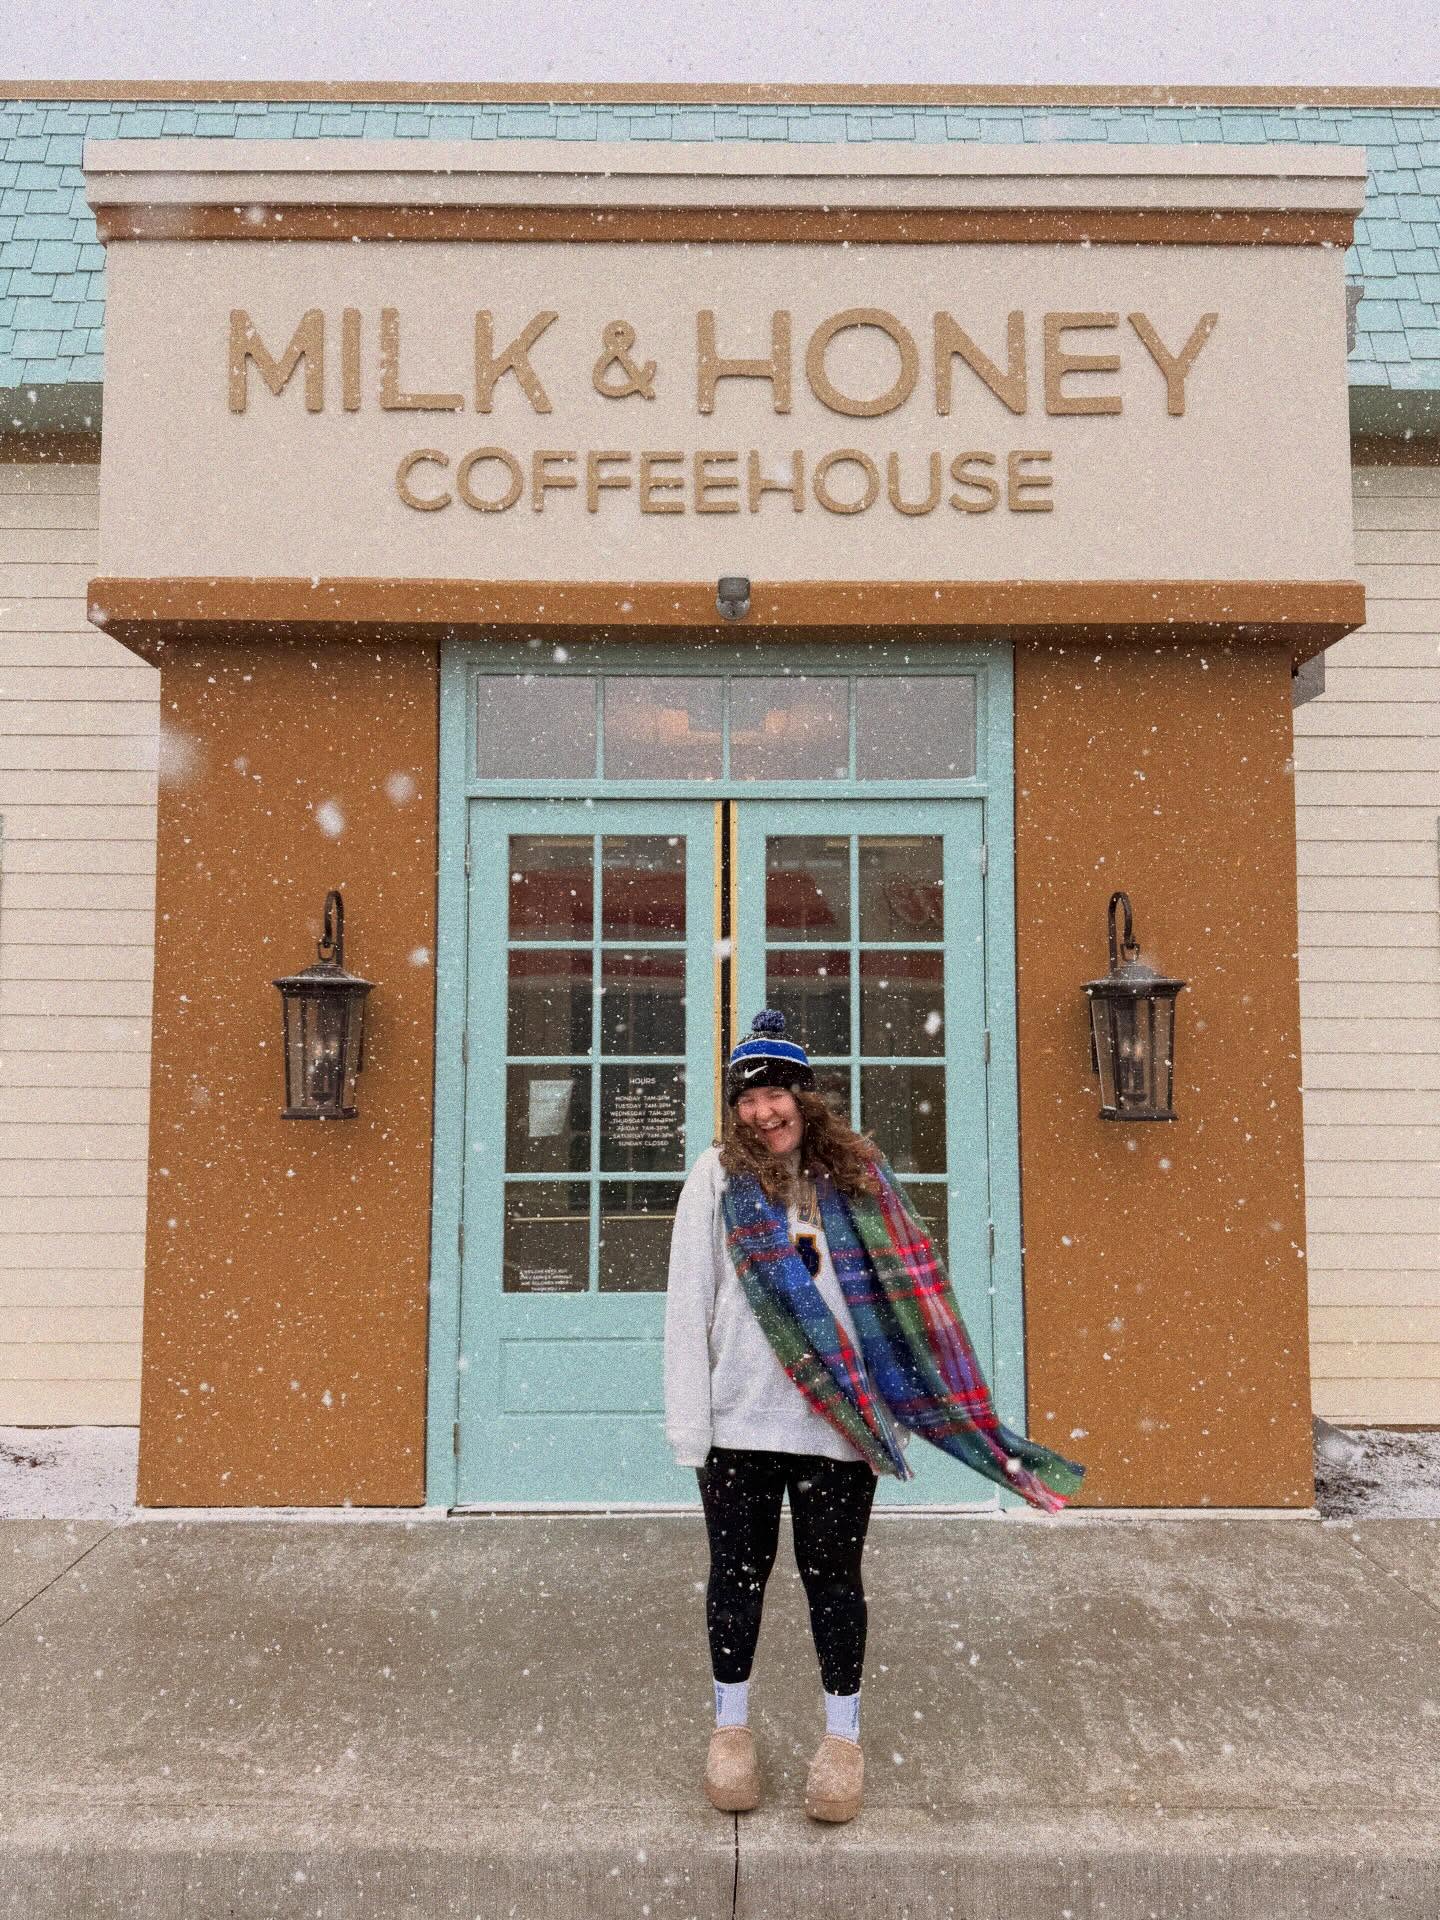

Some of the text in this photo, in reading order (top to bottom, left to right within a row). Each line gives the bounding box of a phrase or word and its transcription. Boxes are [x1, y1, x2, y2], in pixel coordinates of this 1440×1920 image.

[229, 307, 1219, 419] MILK & HONEY
[395, 447, 1055, 518] COFFEEHOUSE
